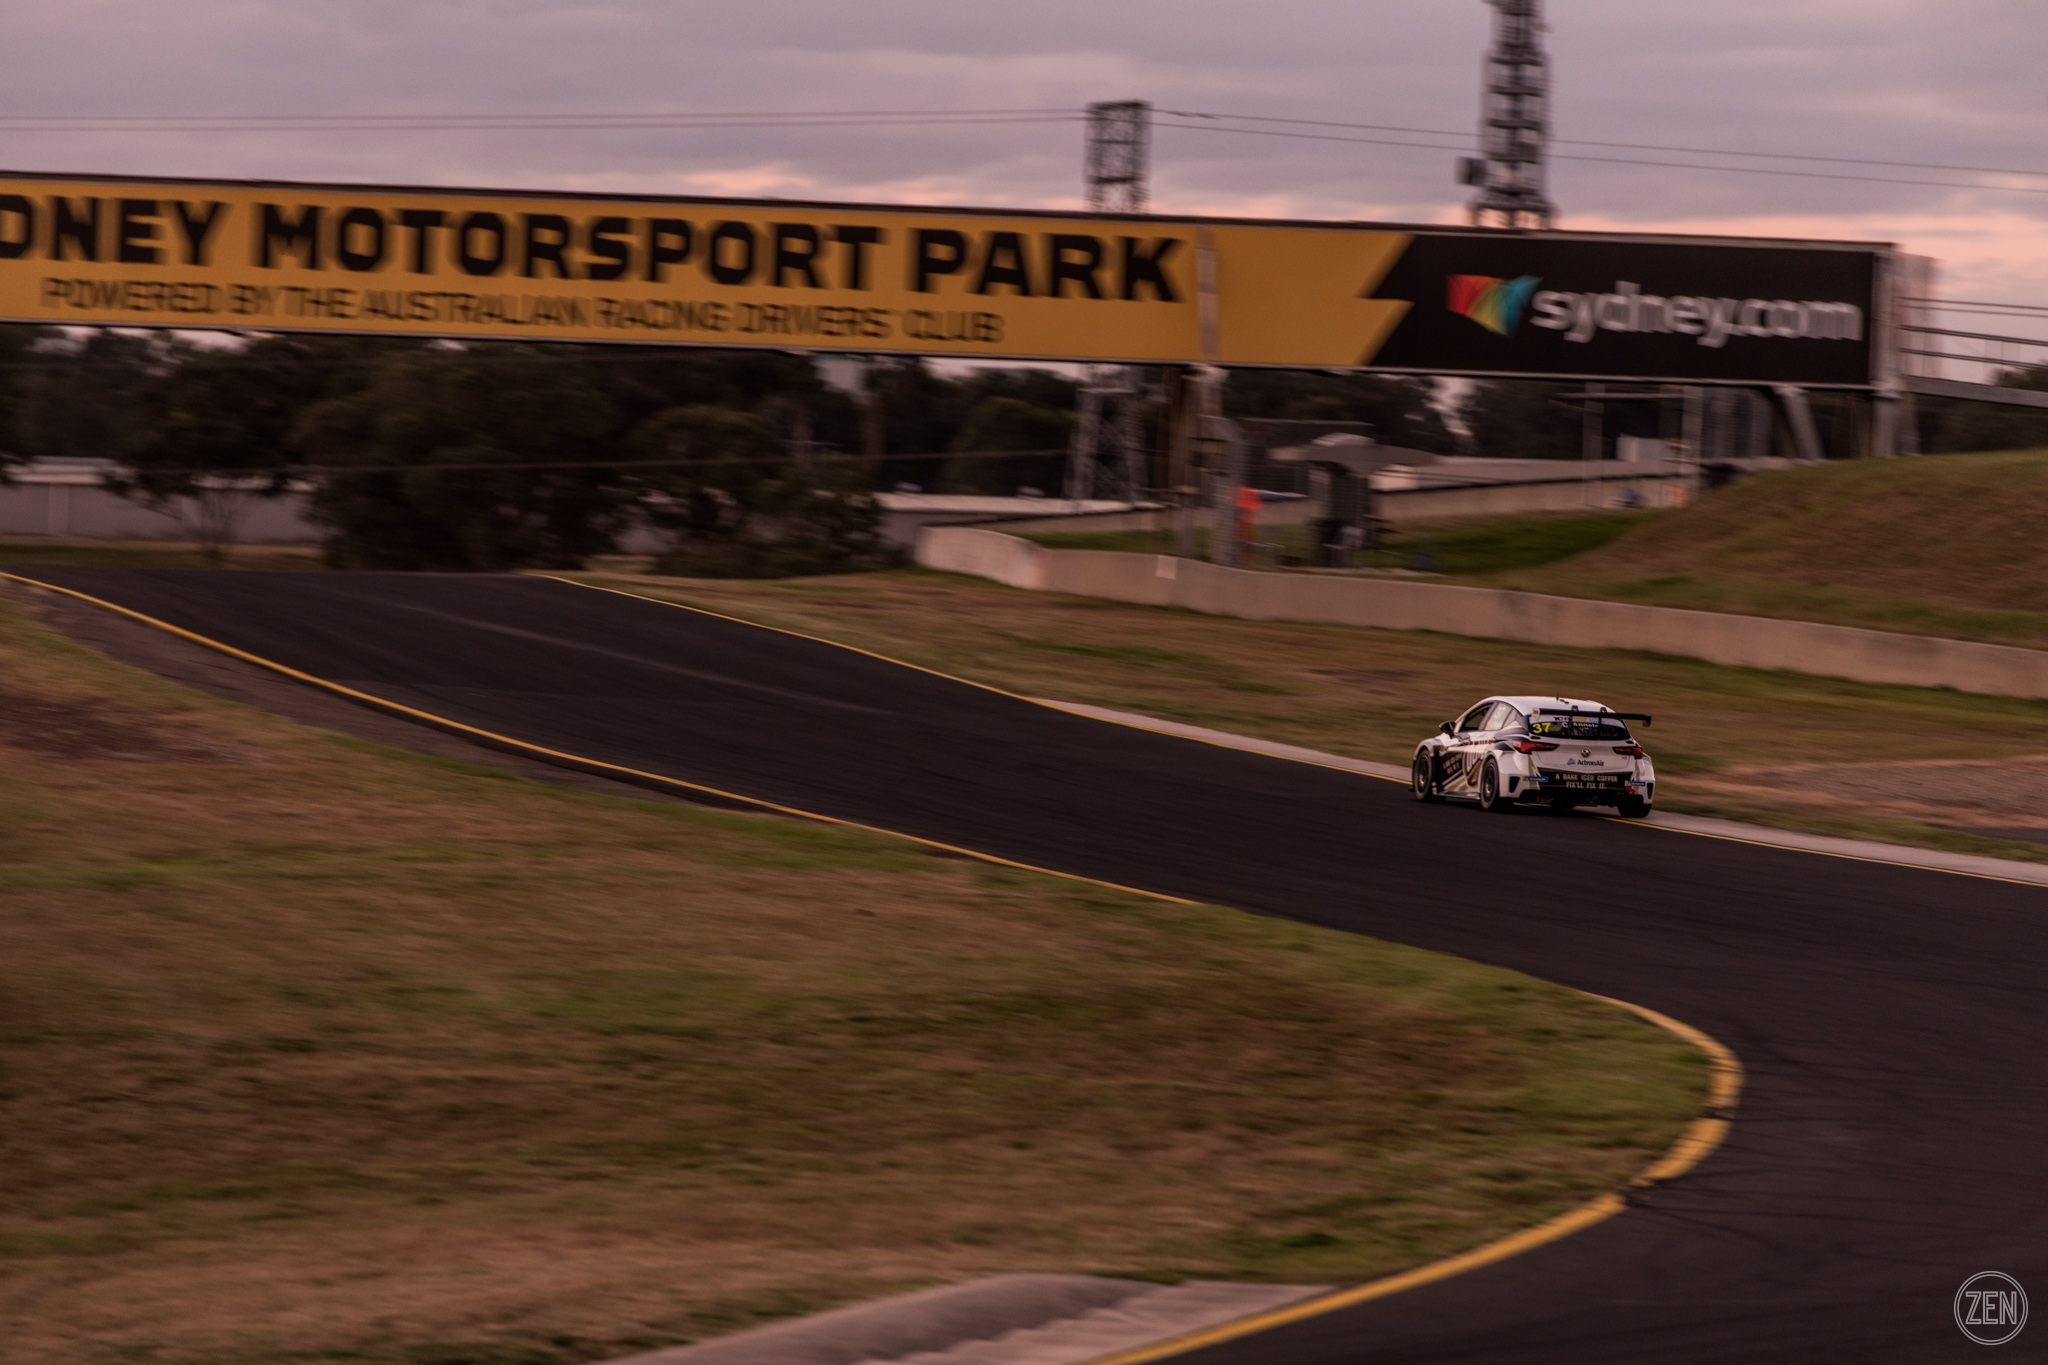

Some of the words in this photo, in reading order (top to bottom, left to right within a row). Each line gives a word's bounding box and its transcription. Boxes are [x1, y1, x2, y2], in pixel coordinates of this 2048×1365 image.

[250, 202, 888, 291] MOTORSPORT
[907, 228, 1189, 303] PARK
[40, 277, 221, 314] POWERED
[227, 283, 278, 316] BY
[281, 286, 358, 319] THE
[360, 289, 590, 328] AUSTRALIAN
[594, 297, 734, 333] RACING
[735, 302, 895, 339] DRIVERS
[901, 308, 1004, 343] CLUB
[1530, 280, 1864, 349] sydney.com
[1532, 722, 1551, 734] 37
[1577, 759, 1605, 767] ActronAir
[1597, 775, 1618, 783] COFFEE
